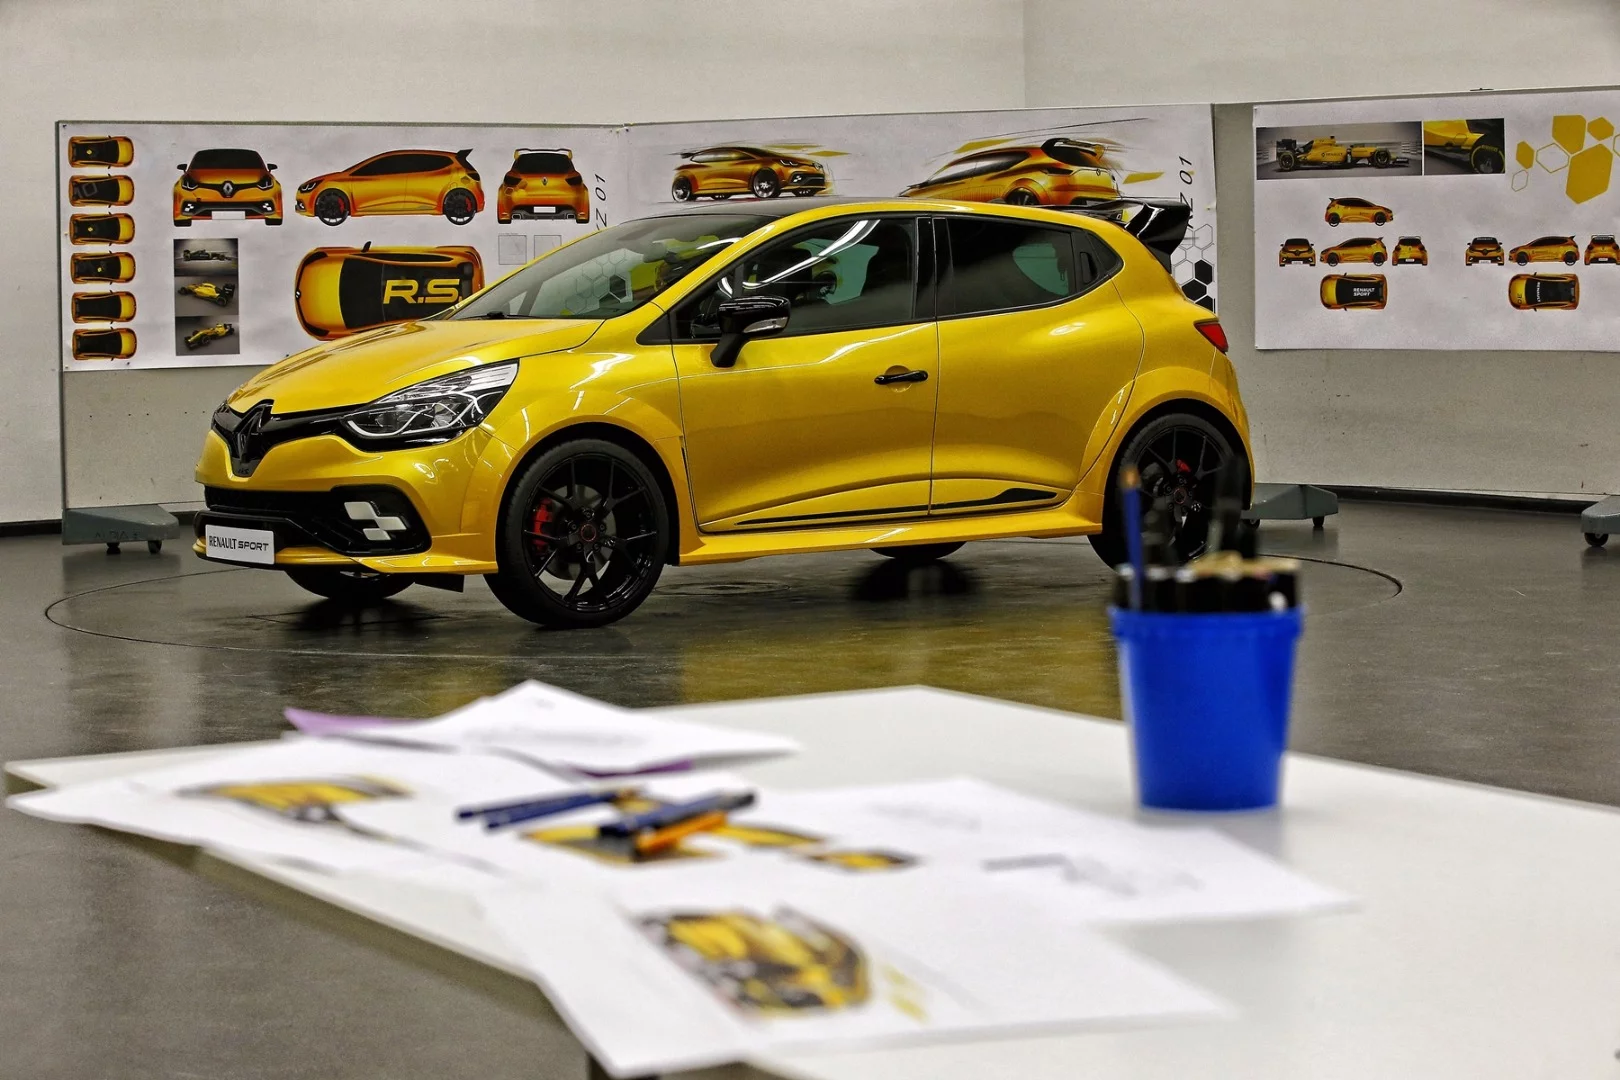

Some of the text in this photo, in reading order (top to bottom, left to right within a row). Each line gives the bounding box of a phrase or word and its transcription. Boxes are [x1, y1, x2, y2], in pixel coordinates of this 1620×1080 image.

[1179, 156, 1192, 185] 01
[594, 173, 607, 231] Z 01
[209, 535, 269, 551] RENAULT SPORT
